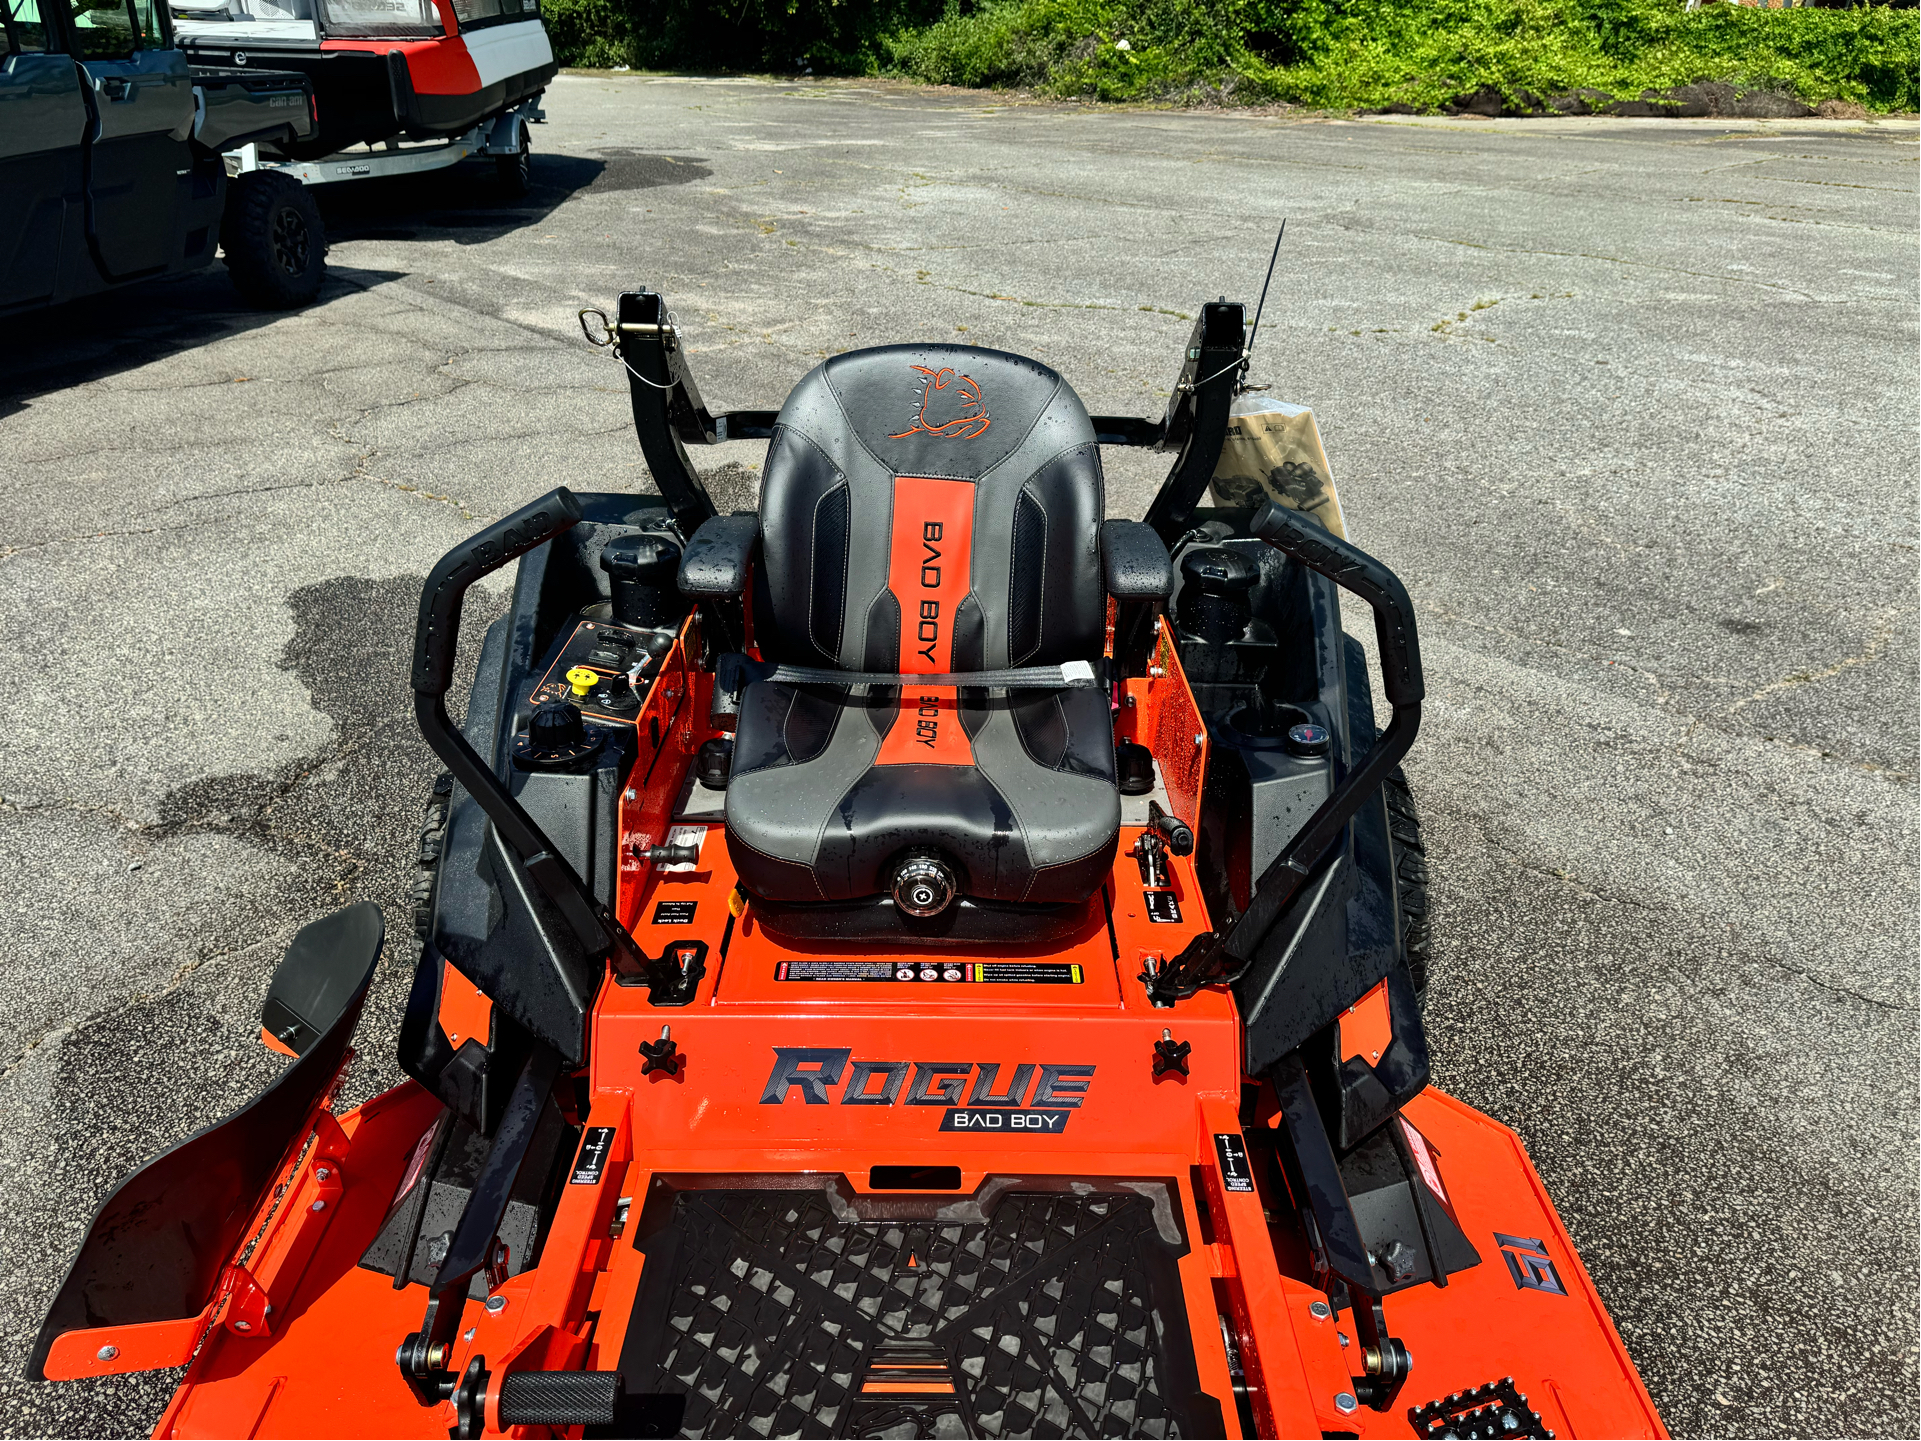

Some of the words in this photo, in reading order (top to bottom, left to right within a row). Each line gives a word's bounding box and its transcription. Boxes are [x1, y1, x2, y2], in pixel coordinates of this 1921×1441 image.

[270, 96, 302, 107] can-am
[921, 521, 943, 588] BAD
[918, 600, 940, 665] BOY
[919, 696, 939, 717] BAD
[916, 721, 938, 749] BOY
[758, 1046, 1097, 1108] ROGUE
[954, 1113, 1002, 1127] BAD
[1011, 1115, 1059, 1128] BOY
